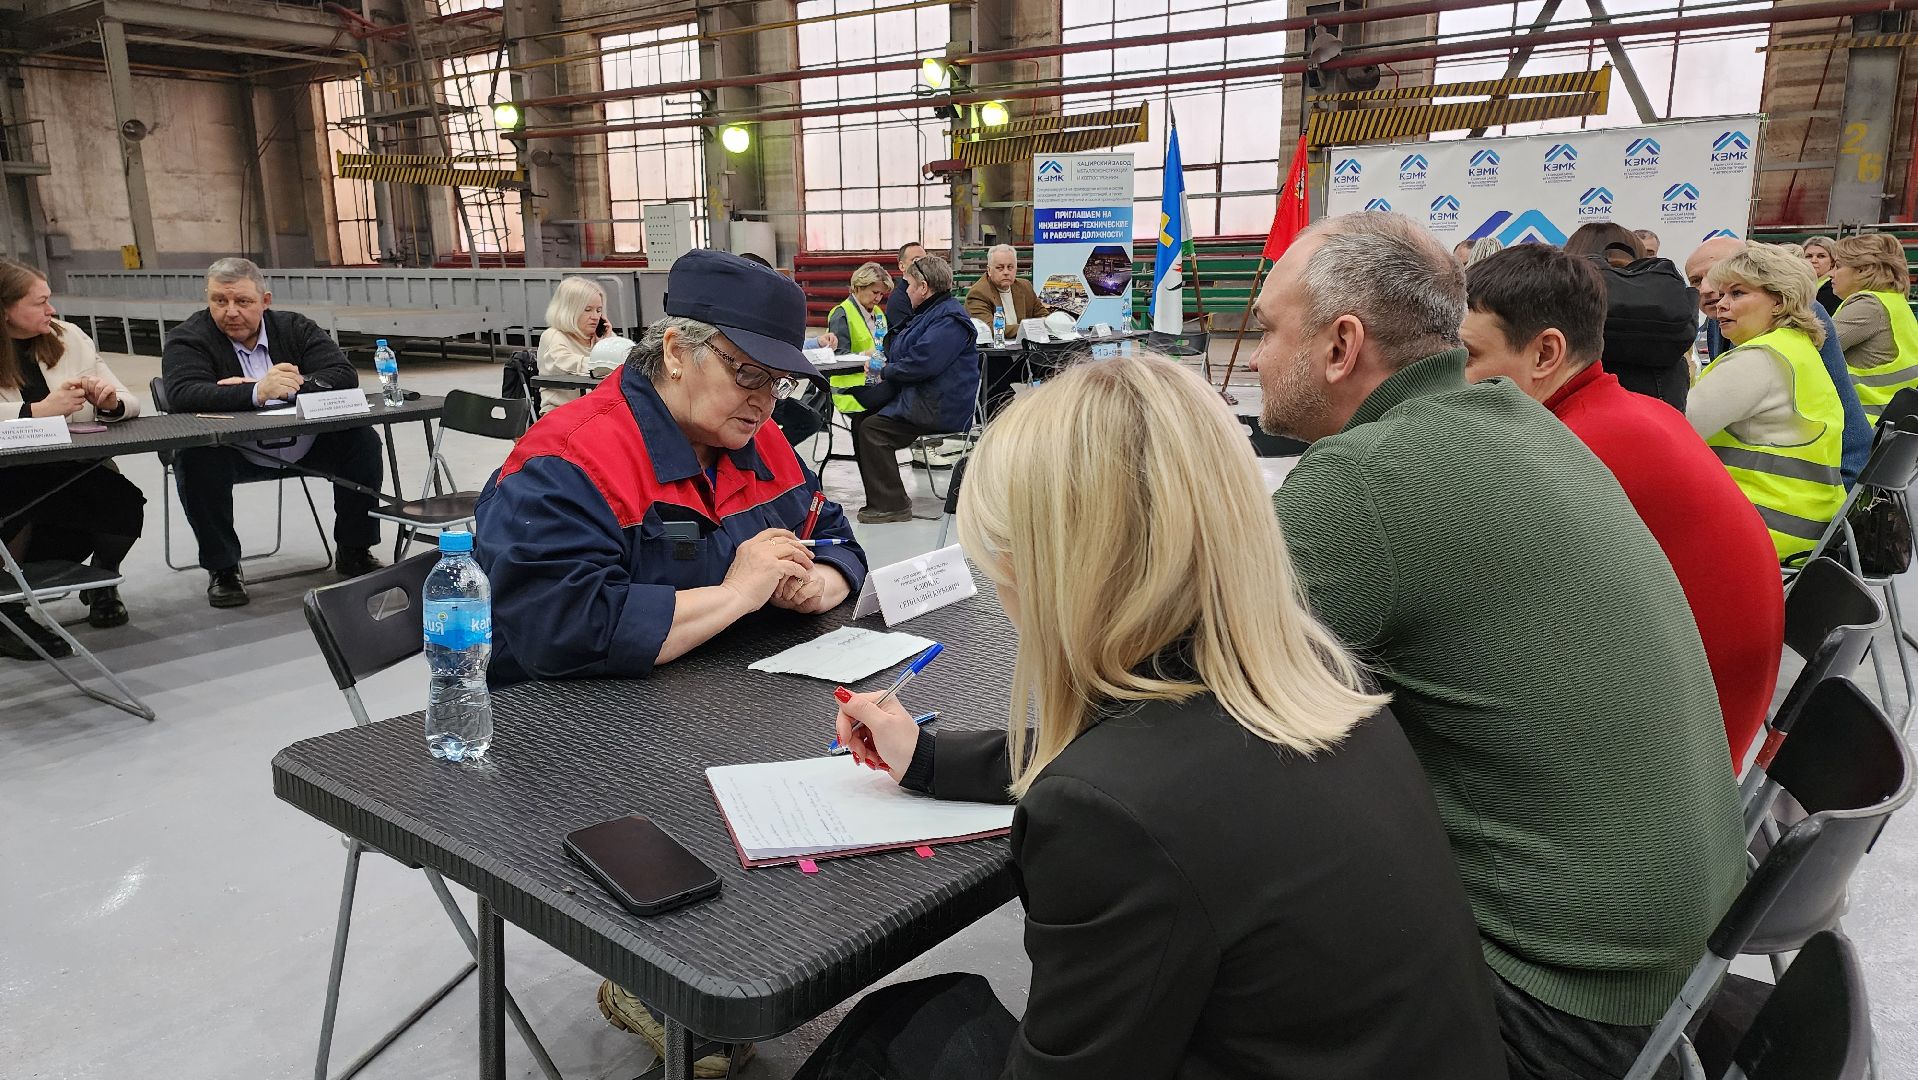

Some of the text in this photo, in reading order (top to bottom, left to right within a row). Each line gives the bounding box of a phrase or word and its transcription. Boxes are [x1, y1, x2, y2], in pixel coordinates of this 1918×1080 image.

[1624, 157, 1660, 166] КЗМК
[1711, 152, 1748, 162] КЗМК
[1468, 167, 1498, 176] КЗМК
[1543, 163, 1576, 172] КЗМК
[1037, 174, 1064, 182] КЗМК
[1334, 175, 1360, 184] КЗМК
[1399, 172, 1426, 180] КЗМК
[1578, 206, 1612, 215] КЗМК
[1662, 202, 1697, 212] КЗМК
[1055, 211, 1101, 219] ПРИГЛАШАЕМ
[1430, 212, 1458, 221] КЗМК
[1038, 221, 1129, 229] ИНЖЕНЕРНО-ТЕХНИЧЕСКИЕ
[1050, 231, 1080, 239] РАБОЧИЕ
[1081, 231, 1124, 239] ДОЛЖНОСТИ
